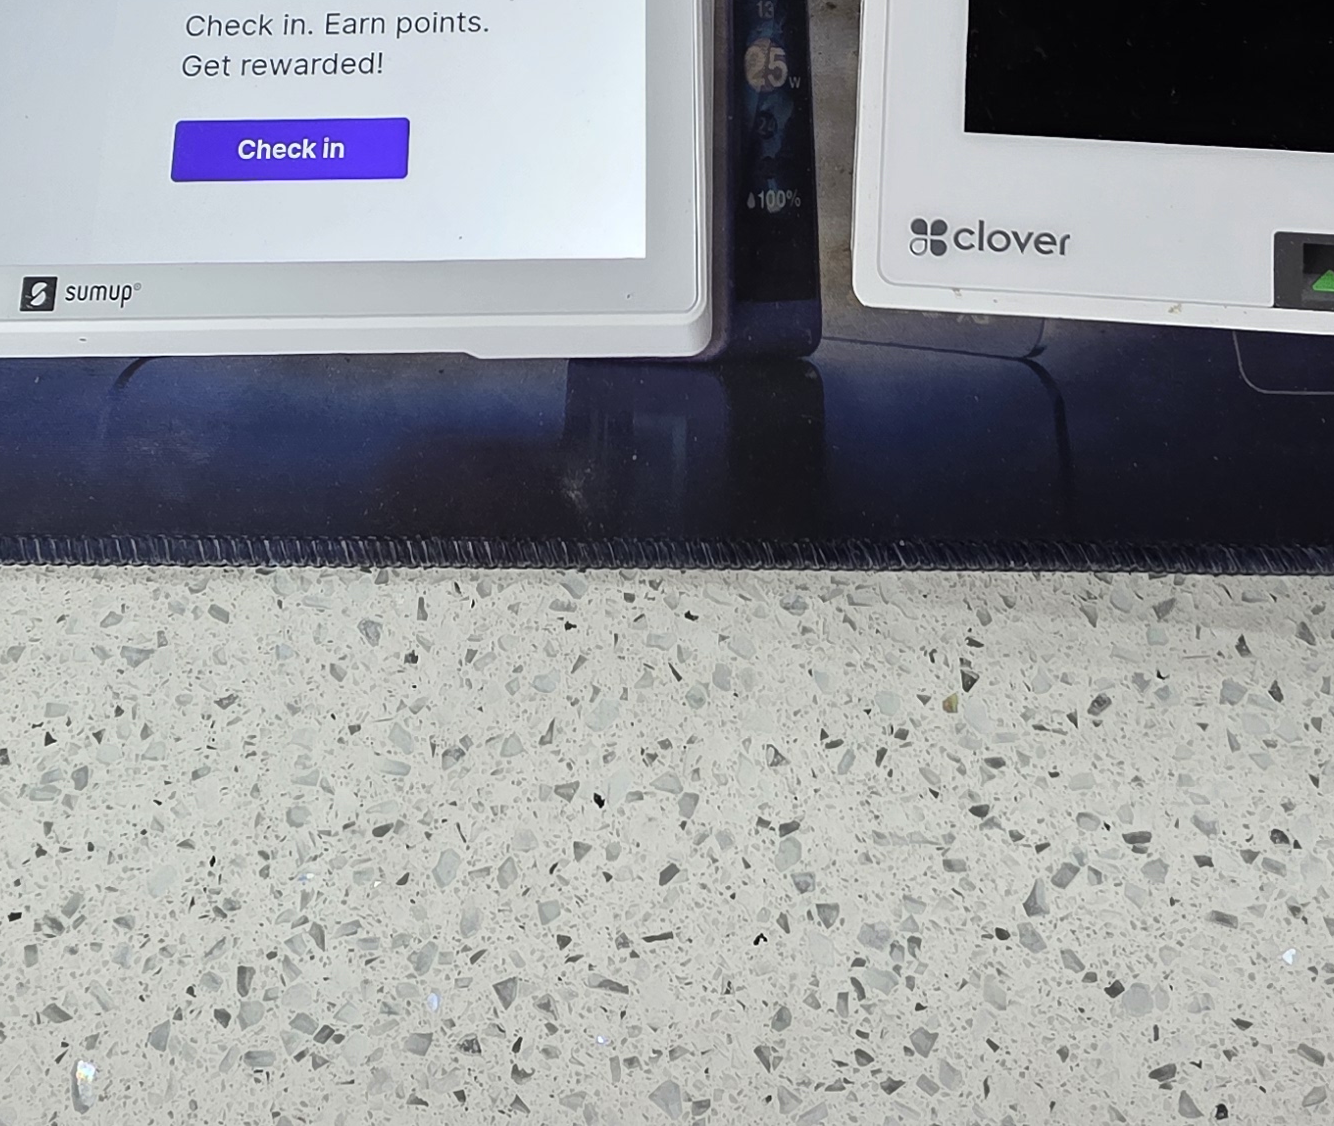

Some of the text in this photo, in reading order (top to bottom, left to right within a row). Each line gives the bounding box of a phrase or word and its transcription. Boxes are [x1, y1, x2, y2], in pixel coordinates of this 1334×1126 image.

[185, 11, 490, 39] Check in. Earn points.
[181, 53, 384, 77] Get rewarded!
[237, 137, 345, 160] Check in
[757, 188, 802, 210] 100%
[952, 218, 1072, 258] clover
[64, 283, 133, 309] sumup
